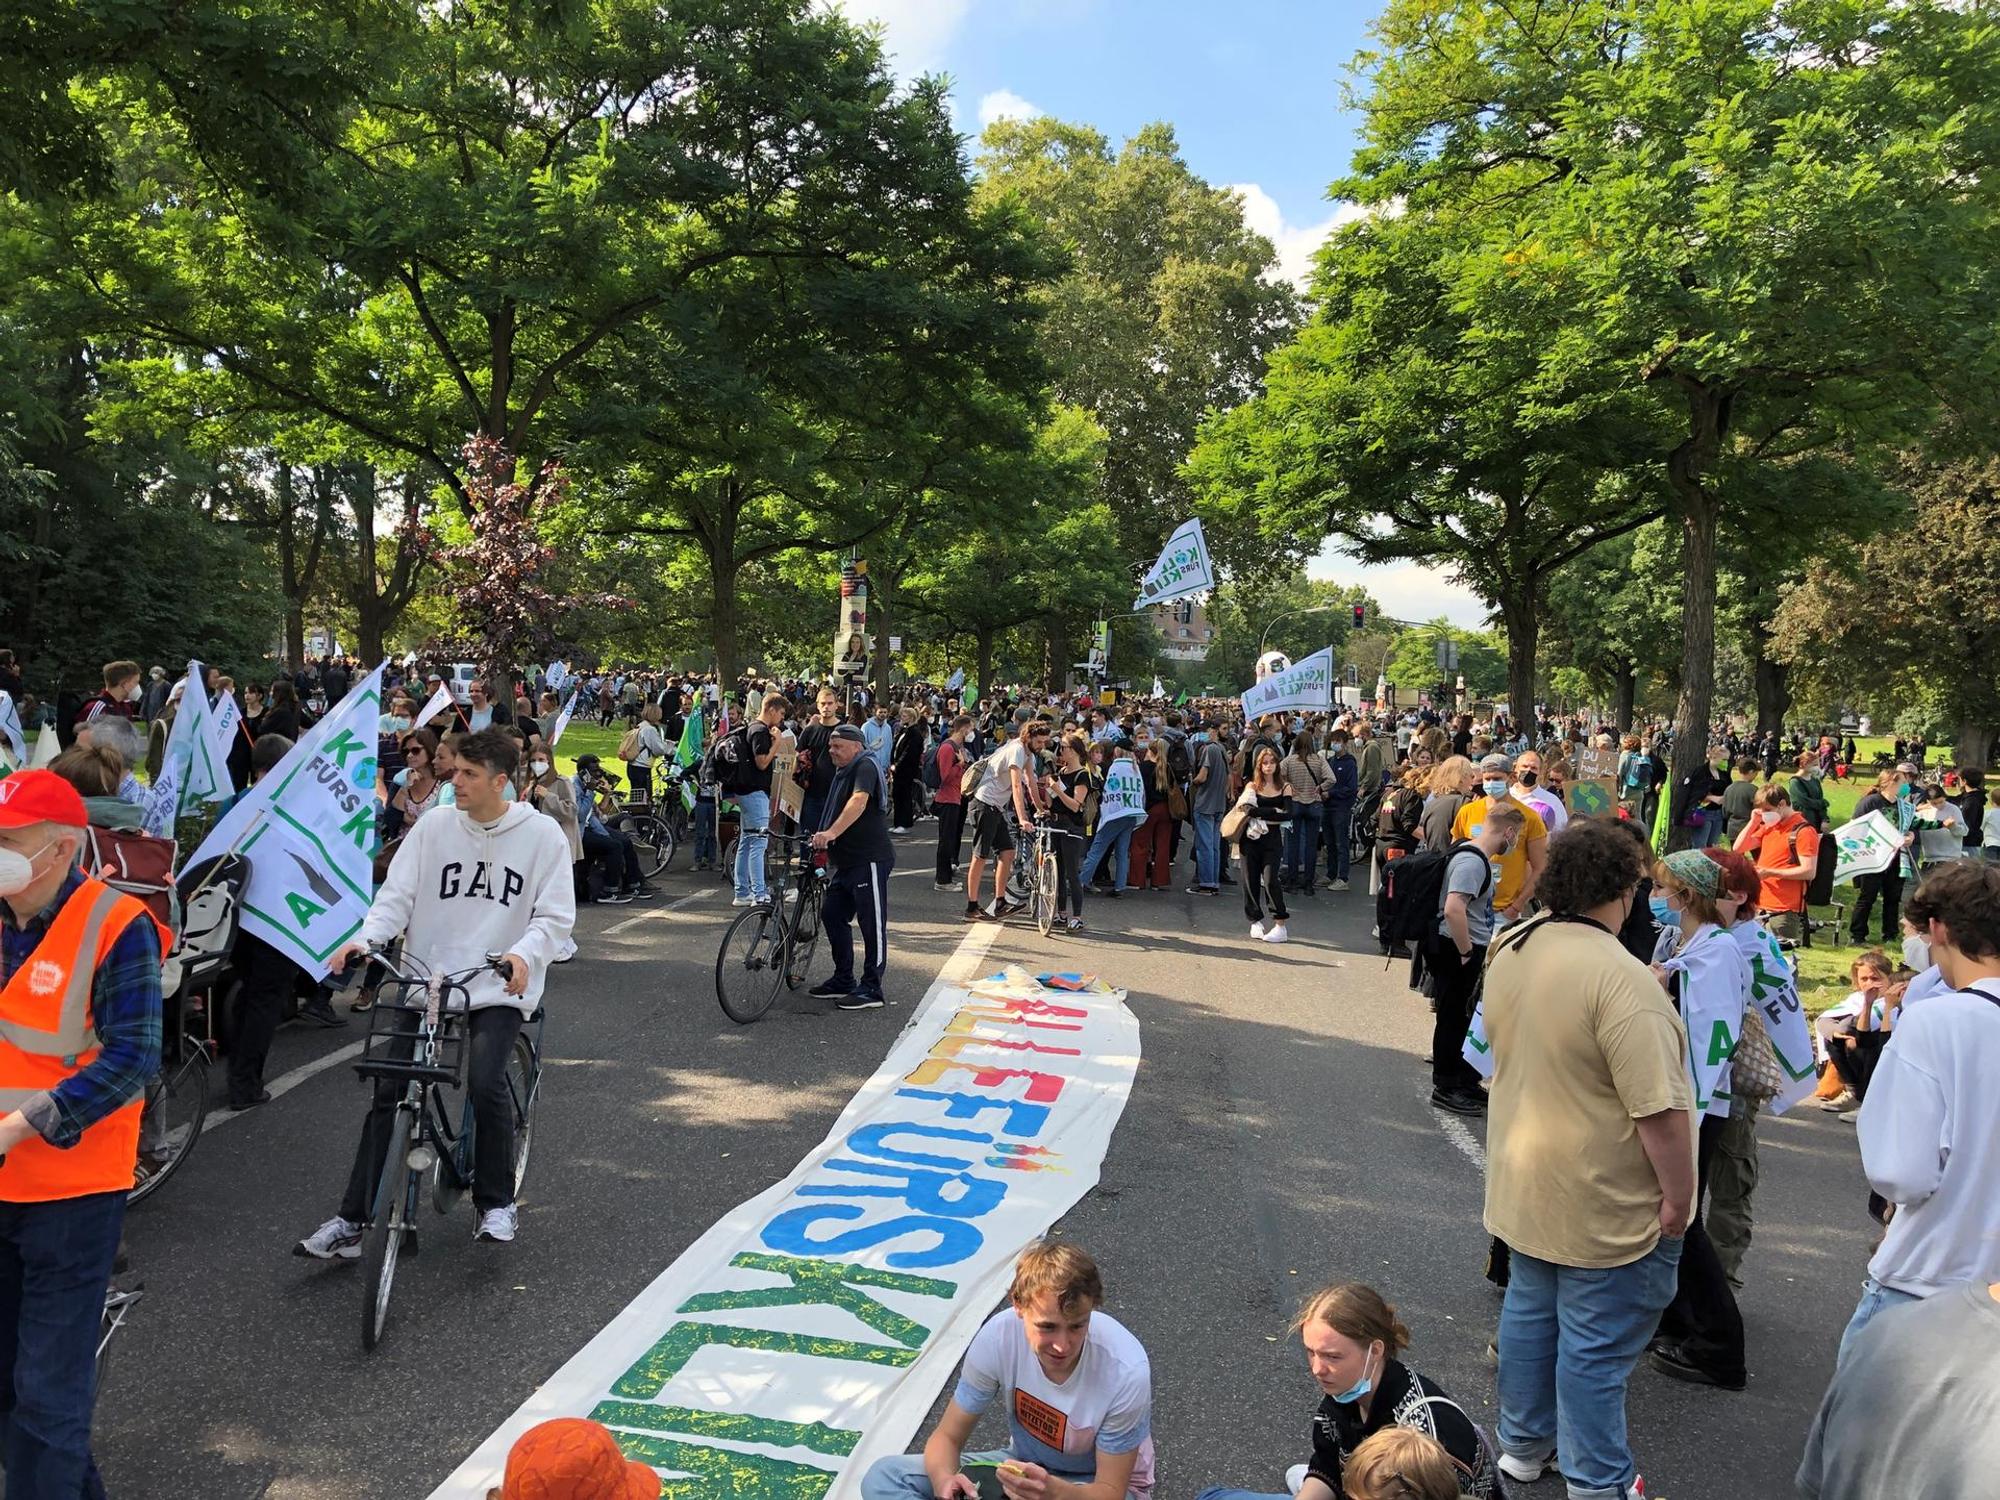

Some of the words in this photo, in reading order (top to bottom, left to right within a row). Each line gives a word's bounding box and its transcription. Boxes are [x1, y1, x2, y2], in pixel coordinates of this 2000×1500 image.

[1583, 750, 1598, 761] DU
[306, 755, 360, 813] FÜRS
[440, 861, 524, 907] GAP
[759, 1088, 1066, 1269] FÜRS
